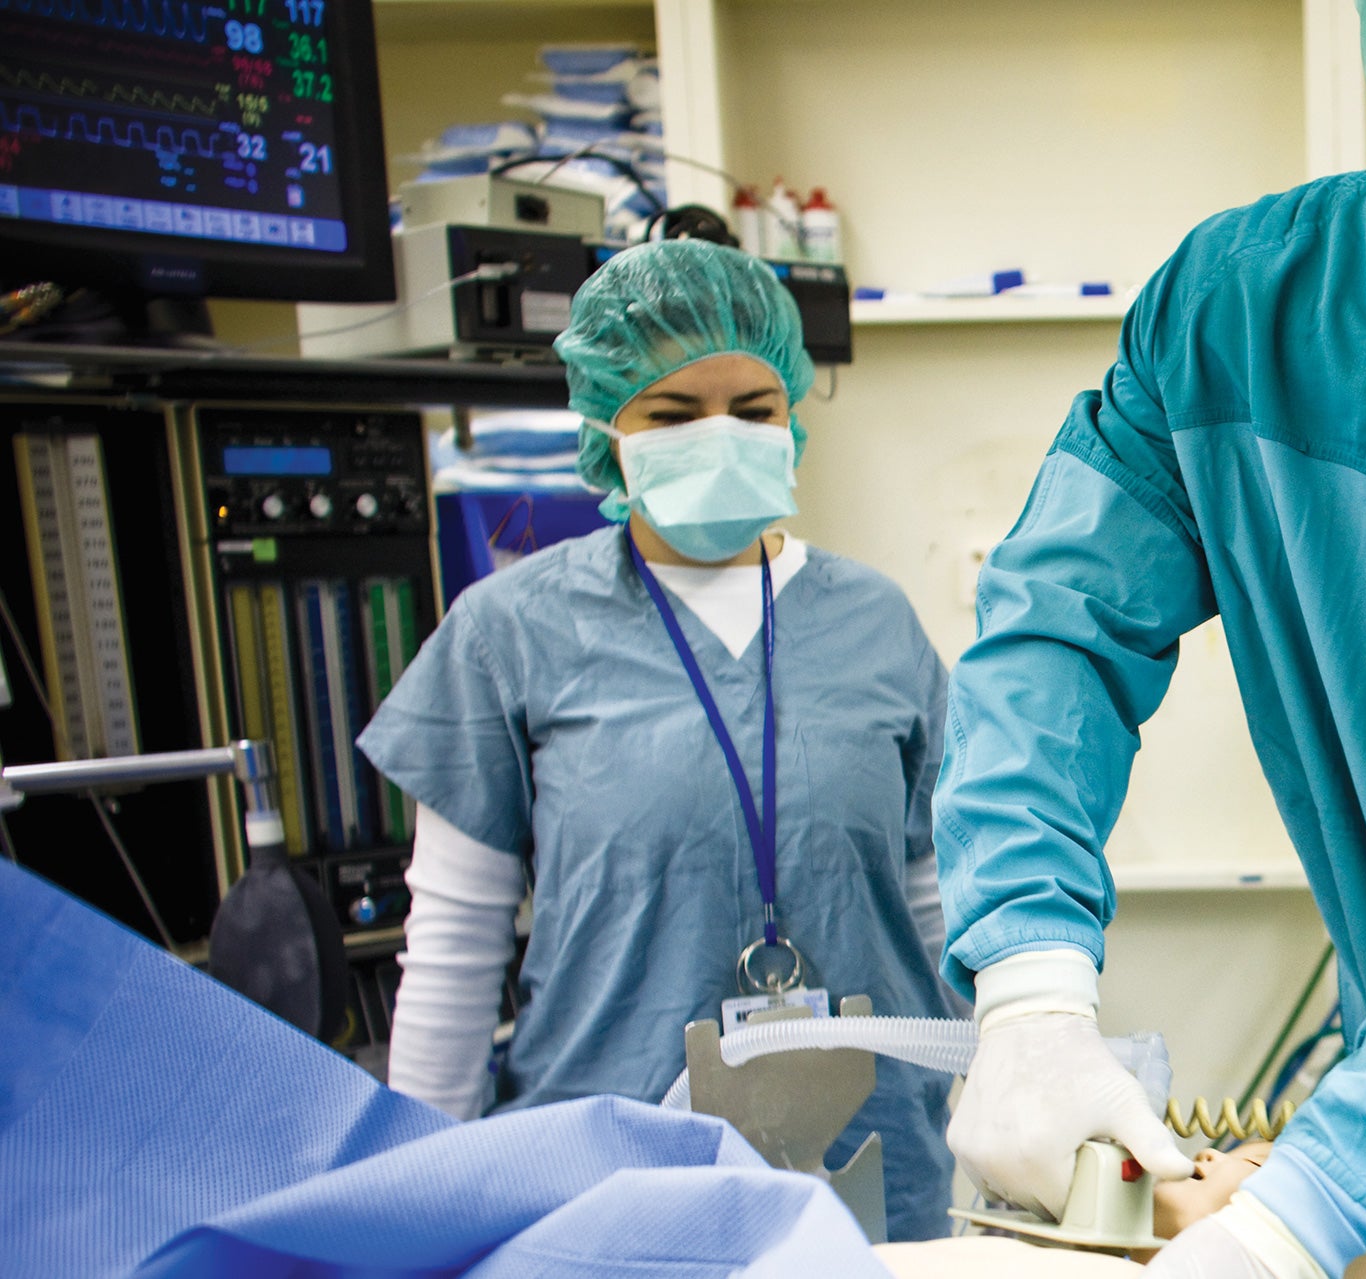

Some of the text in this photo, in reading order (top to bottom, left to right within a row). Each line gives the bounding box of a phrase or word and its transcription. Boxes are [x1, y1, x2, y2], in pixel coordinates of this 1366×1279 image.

[284, 0, 325, 27] 117
[224, 19, 264, 54] 98
[288, 32, 328, 64] 36.1
[292, 69, 334, 103] 37.2
[236, 132, 267, 160] 32
[298, 142, 334, 175] 21
